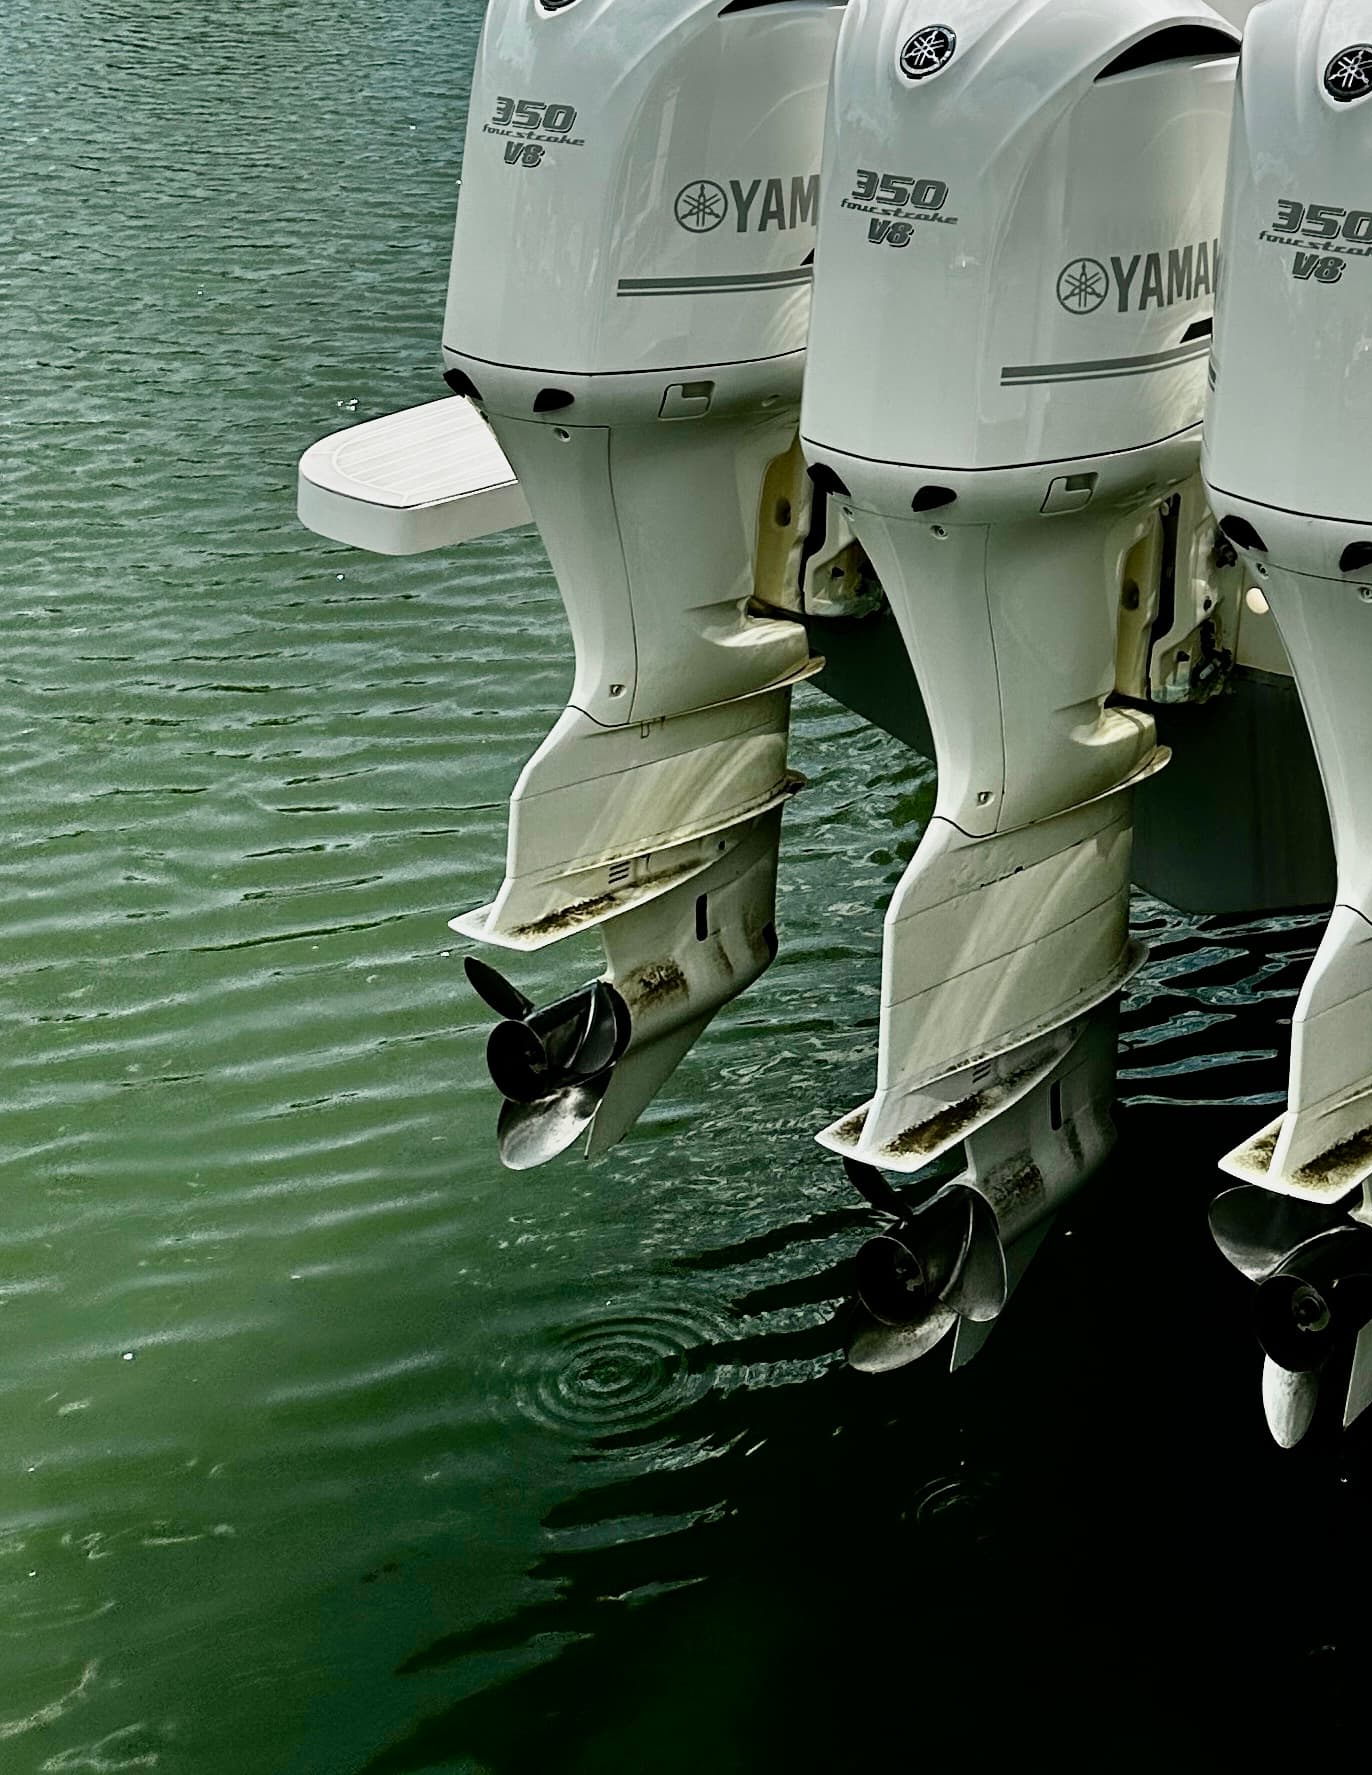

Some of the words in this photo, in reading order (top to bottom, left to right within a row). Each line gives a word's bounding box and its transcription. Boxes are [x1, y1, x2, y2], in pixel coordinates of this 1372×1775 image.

[492, 96, 577, 133] 350
[504, 141, 545, 168] V8
[729, 174, 820, 232] YAM
[852, 169, 949, 210] 350
[868, 218, 915, 248] V8
[1292, 251, 1347, 283] V8
